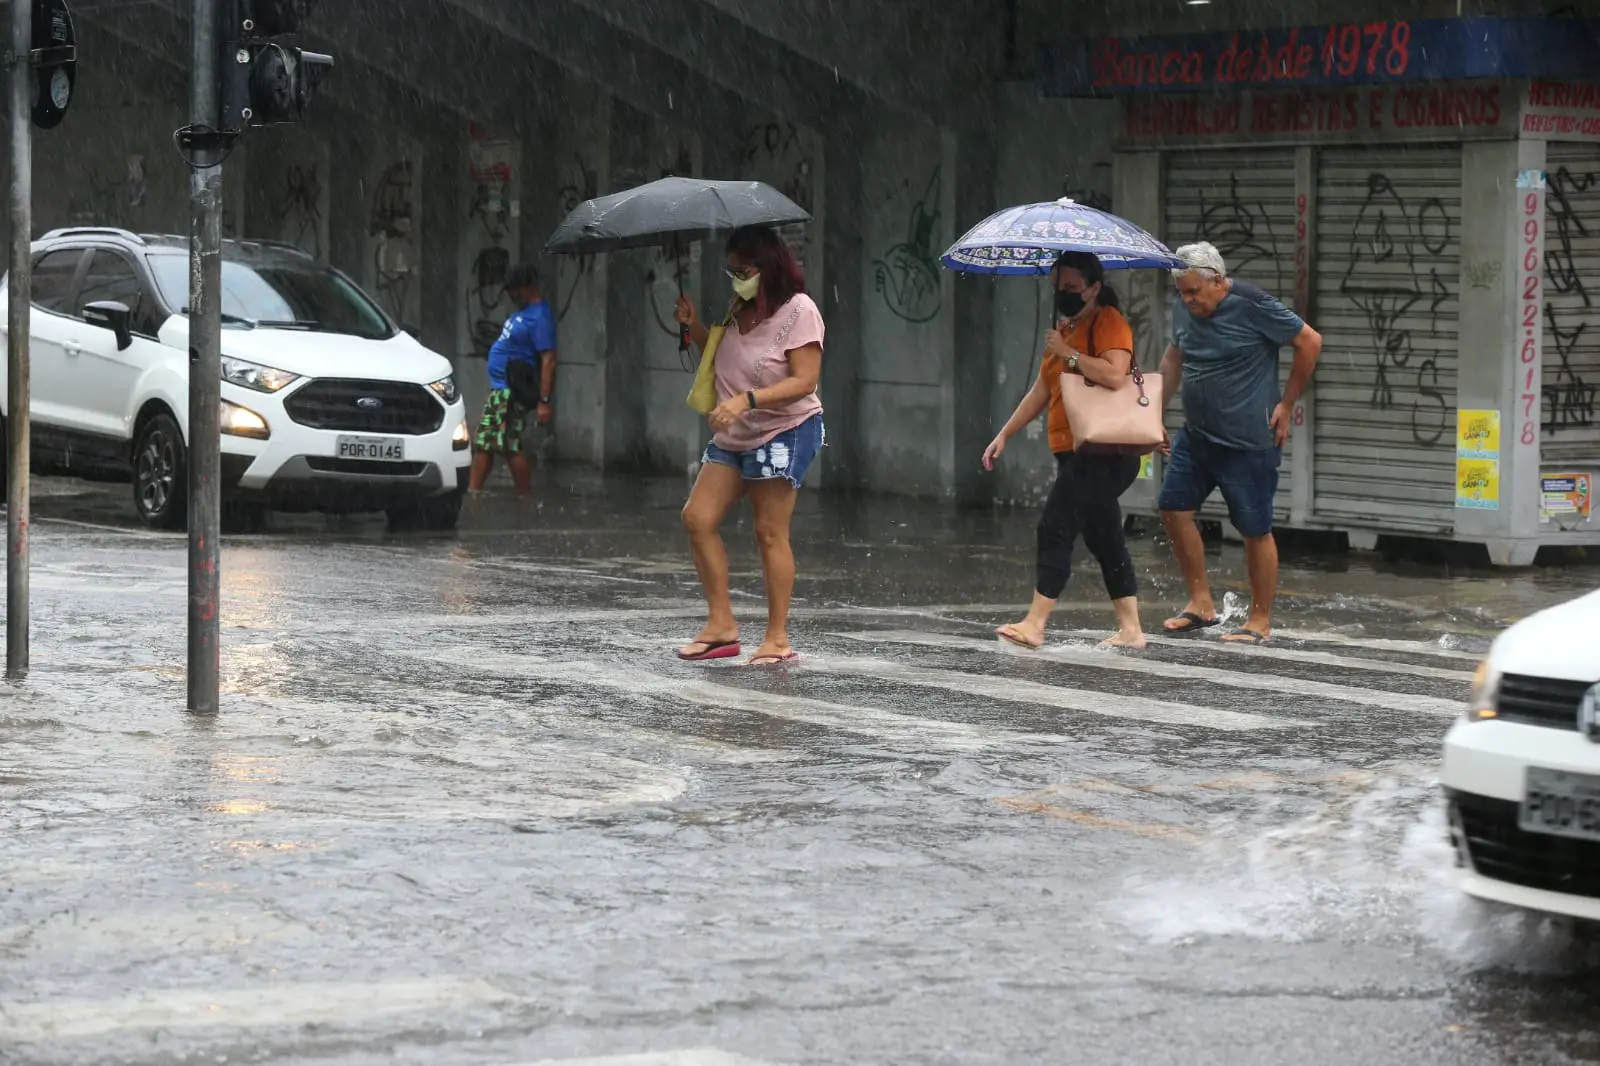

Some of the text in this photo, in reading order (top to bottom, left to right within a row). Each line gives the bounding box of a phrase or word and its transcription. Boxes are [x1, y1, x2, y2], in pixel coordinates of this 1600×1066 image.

[1090, 20, 1411, 87] Banca desde 1978
[1252, 92, 1358, 131] REVISTAS
[1369, 90, 1385, 128] E
[1393, 85, 1501, 127] CIGARROS
